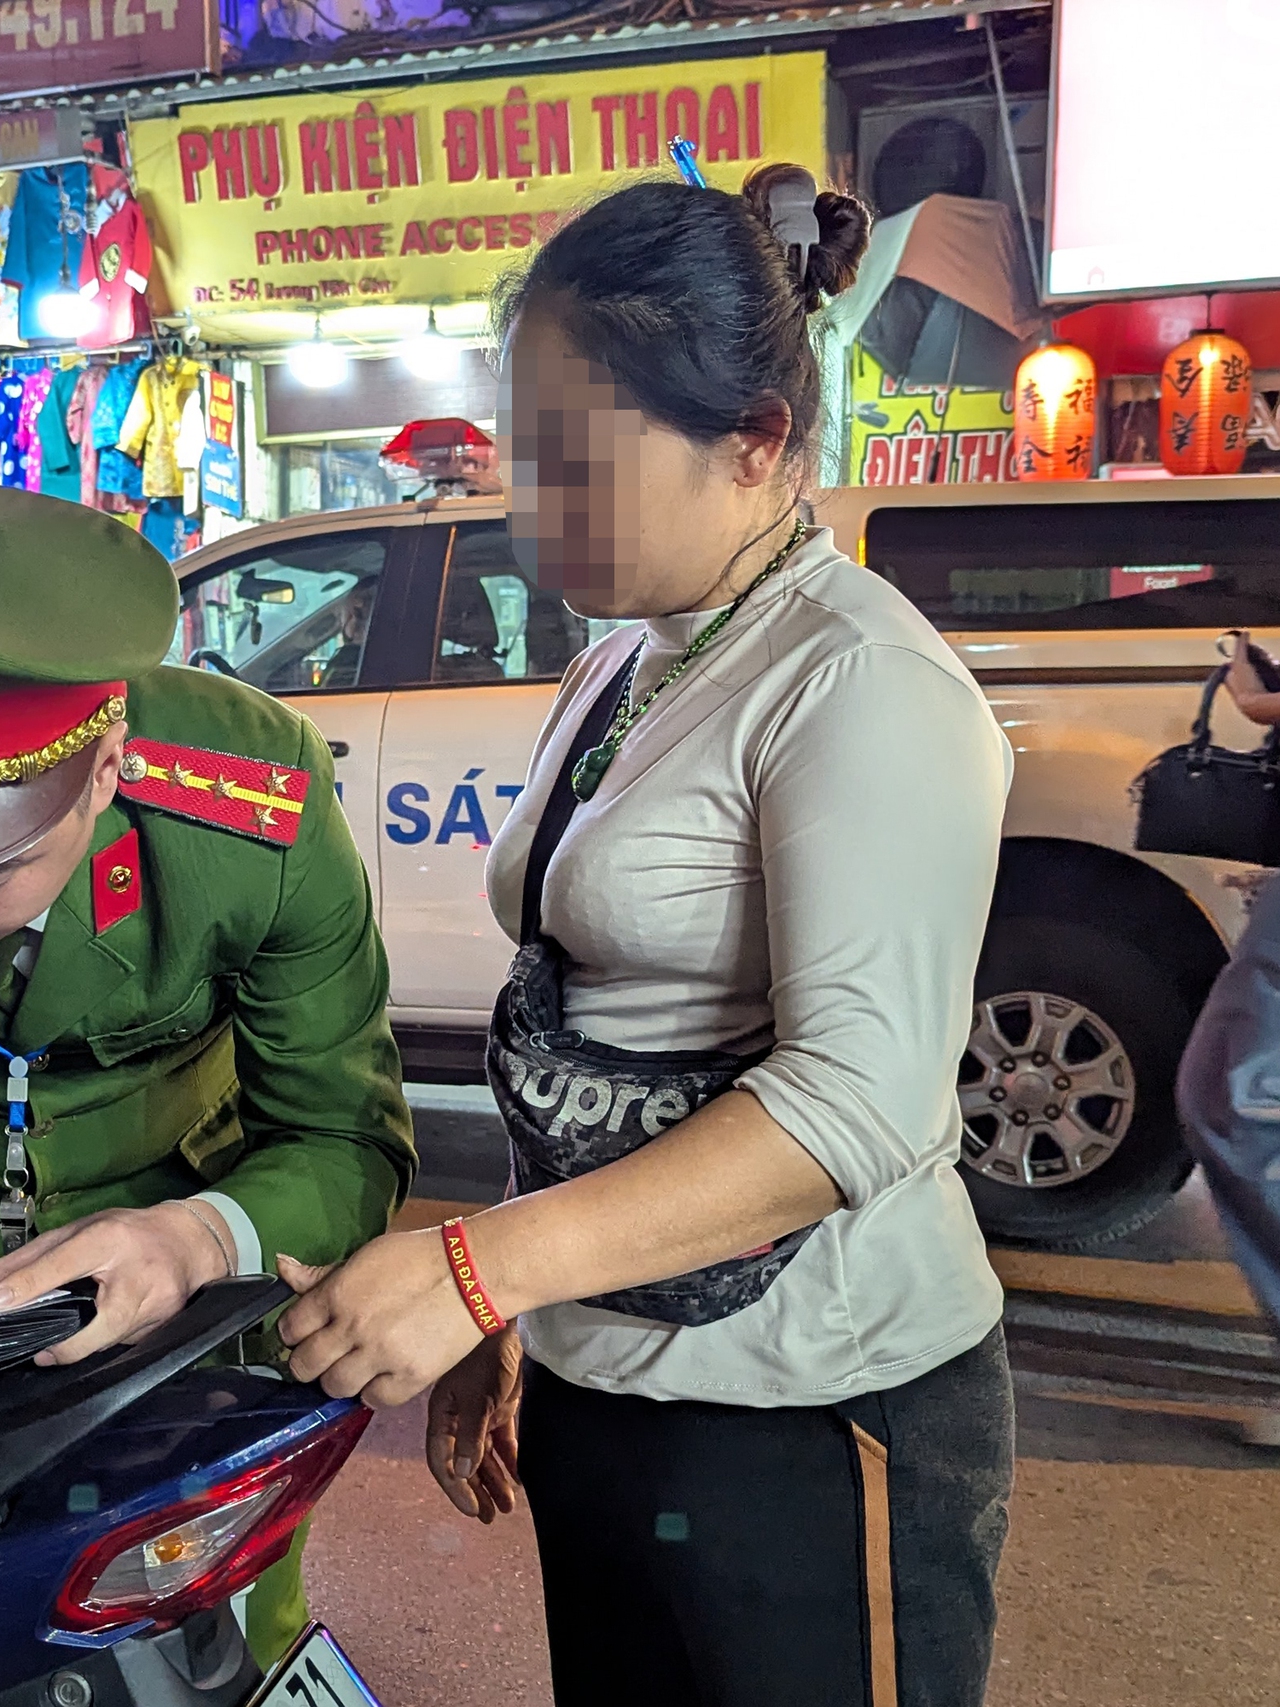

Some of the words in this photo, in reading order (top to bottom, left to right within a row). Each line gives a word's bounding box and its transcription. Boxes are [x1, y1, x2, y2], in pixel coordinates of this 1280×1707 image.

[178, 122, 285, 211] PHỤ
[299, 101, 421, 204] KIỆN
[442, 86, 572, 192] ĐIỆN
[255, 223, 389, 267] PHONE
[400, 207, 585, 258] ACCESS
[228, 278, 260, 301] 54
[505, 1051, 708, 1137] upre
[448, 1237, 460, 1248] A
[451, 1247, 467, 1265] DI
[458, 1265, 478, 1292] ĐÀ
[469, 1292, 499, 1330] PHẬT
